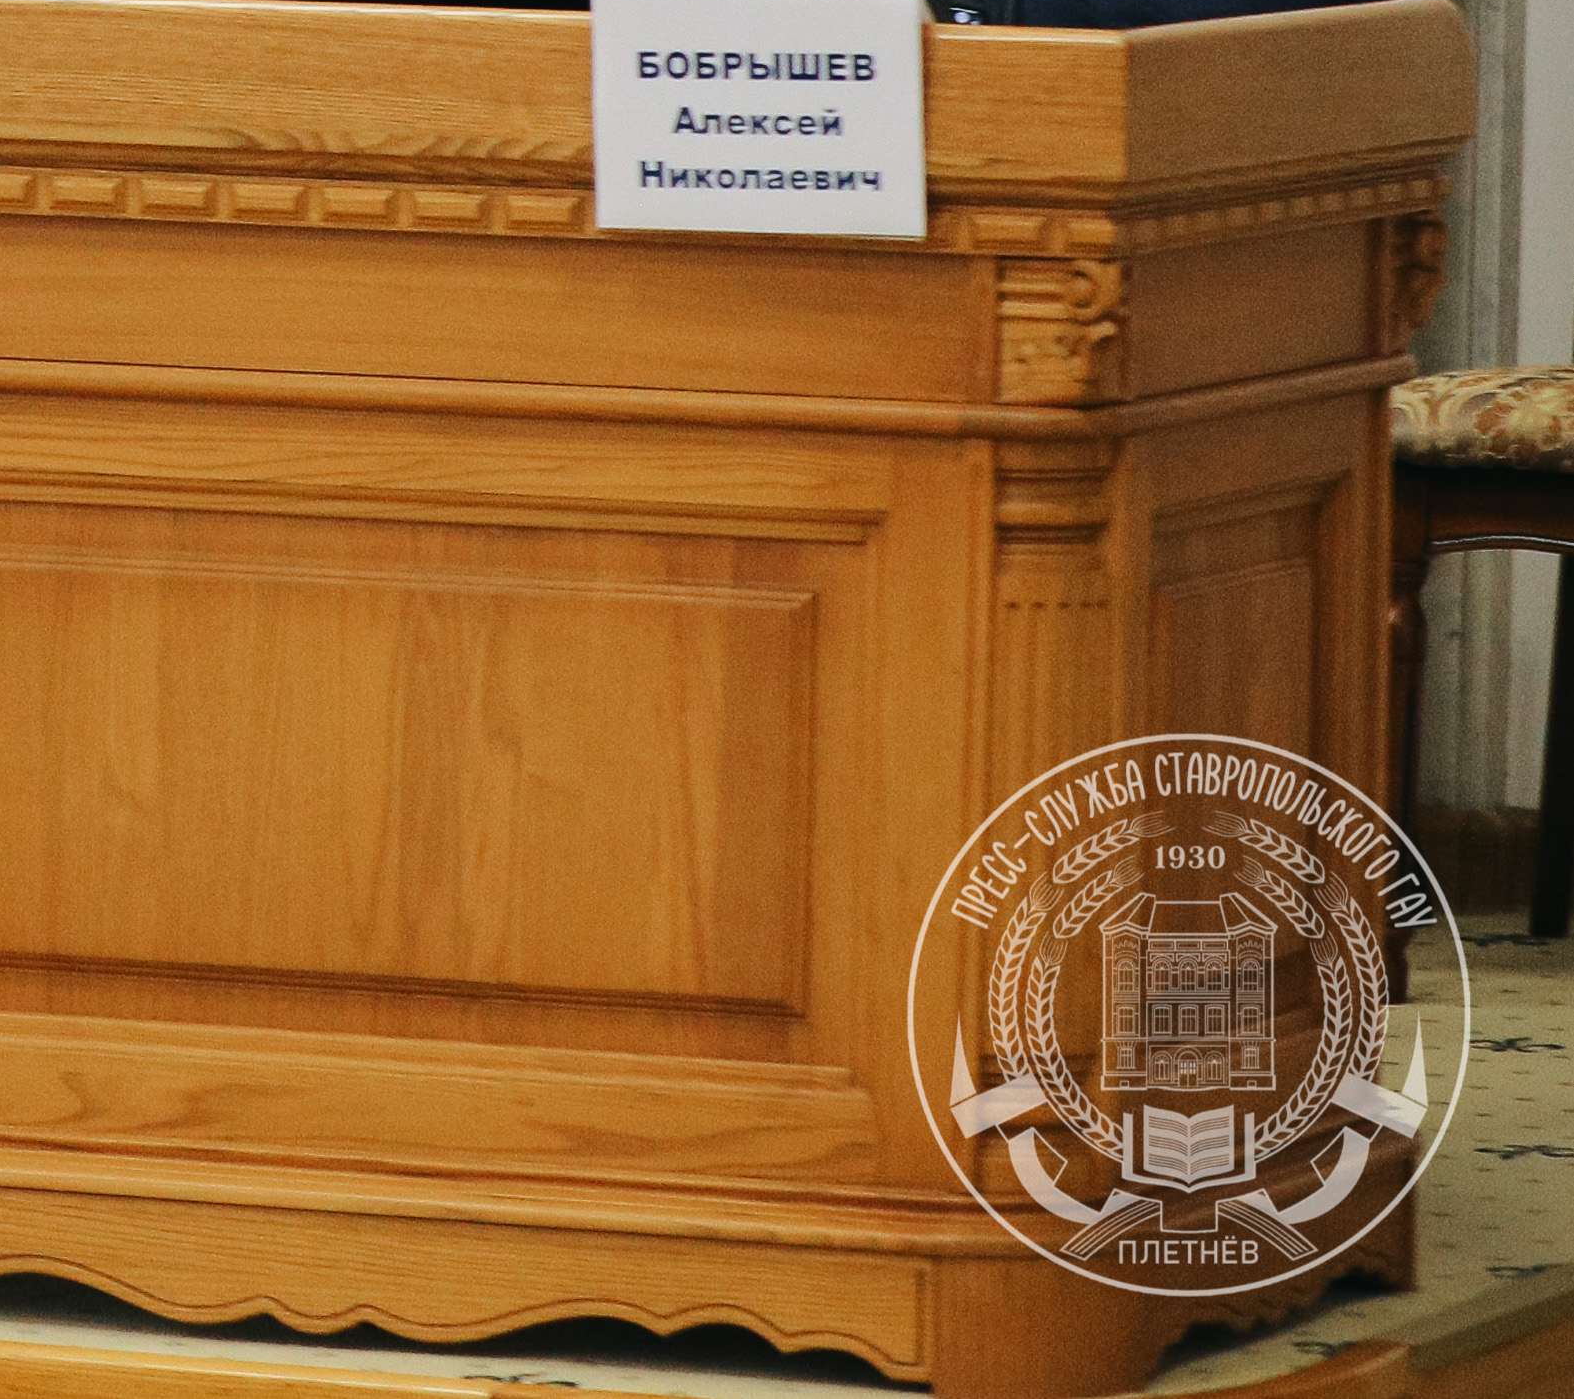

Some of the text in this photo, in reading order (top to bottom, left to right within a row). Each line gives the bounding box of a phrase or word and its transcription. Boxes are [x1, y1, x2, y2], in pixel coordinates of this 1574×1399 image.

[637, 51, 875, 81] БОБРЫШЕВ
[673, 106, 842, 135] Алексей
[639, 160, 881, 191] Николаевич
